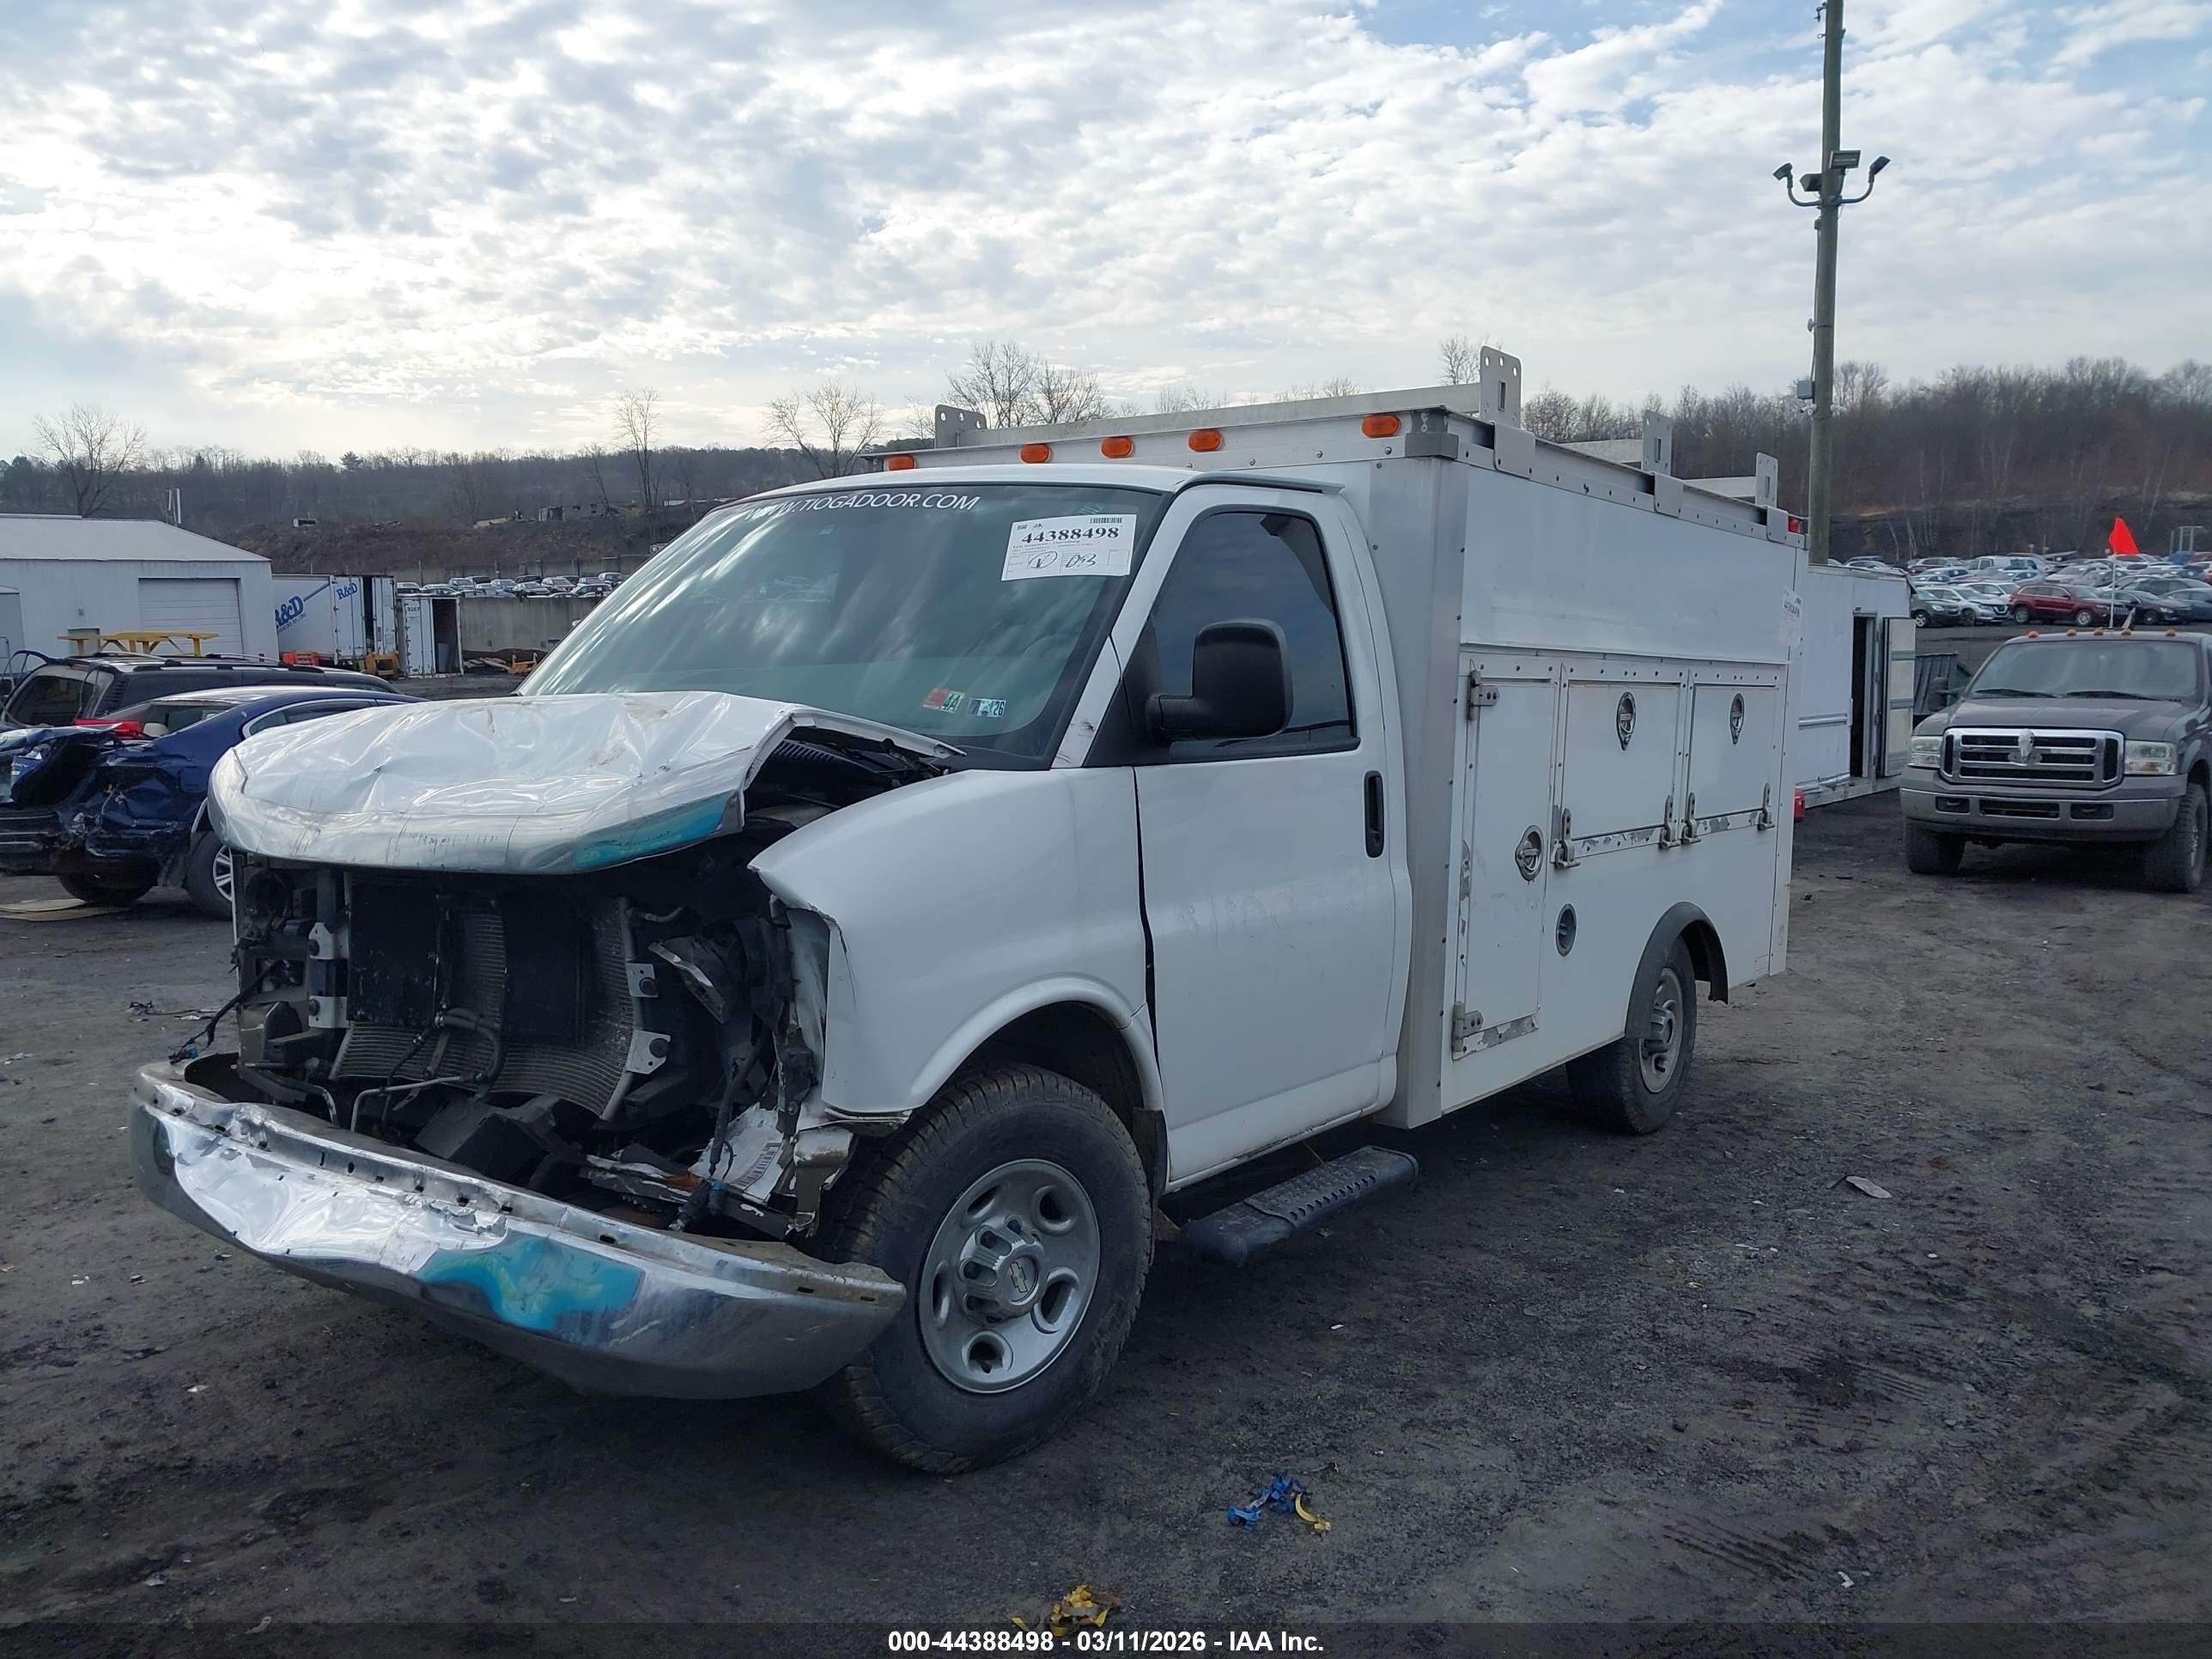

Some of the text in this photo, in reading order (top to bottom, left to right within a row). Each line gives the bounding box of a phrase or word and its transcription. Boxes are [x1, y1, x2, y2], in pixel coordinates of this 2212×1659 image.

[1022, 526, 1119, 544] 44388498
[337, 582, 358, 600] R&D
[994, 701, 1005, 715] 26
